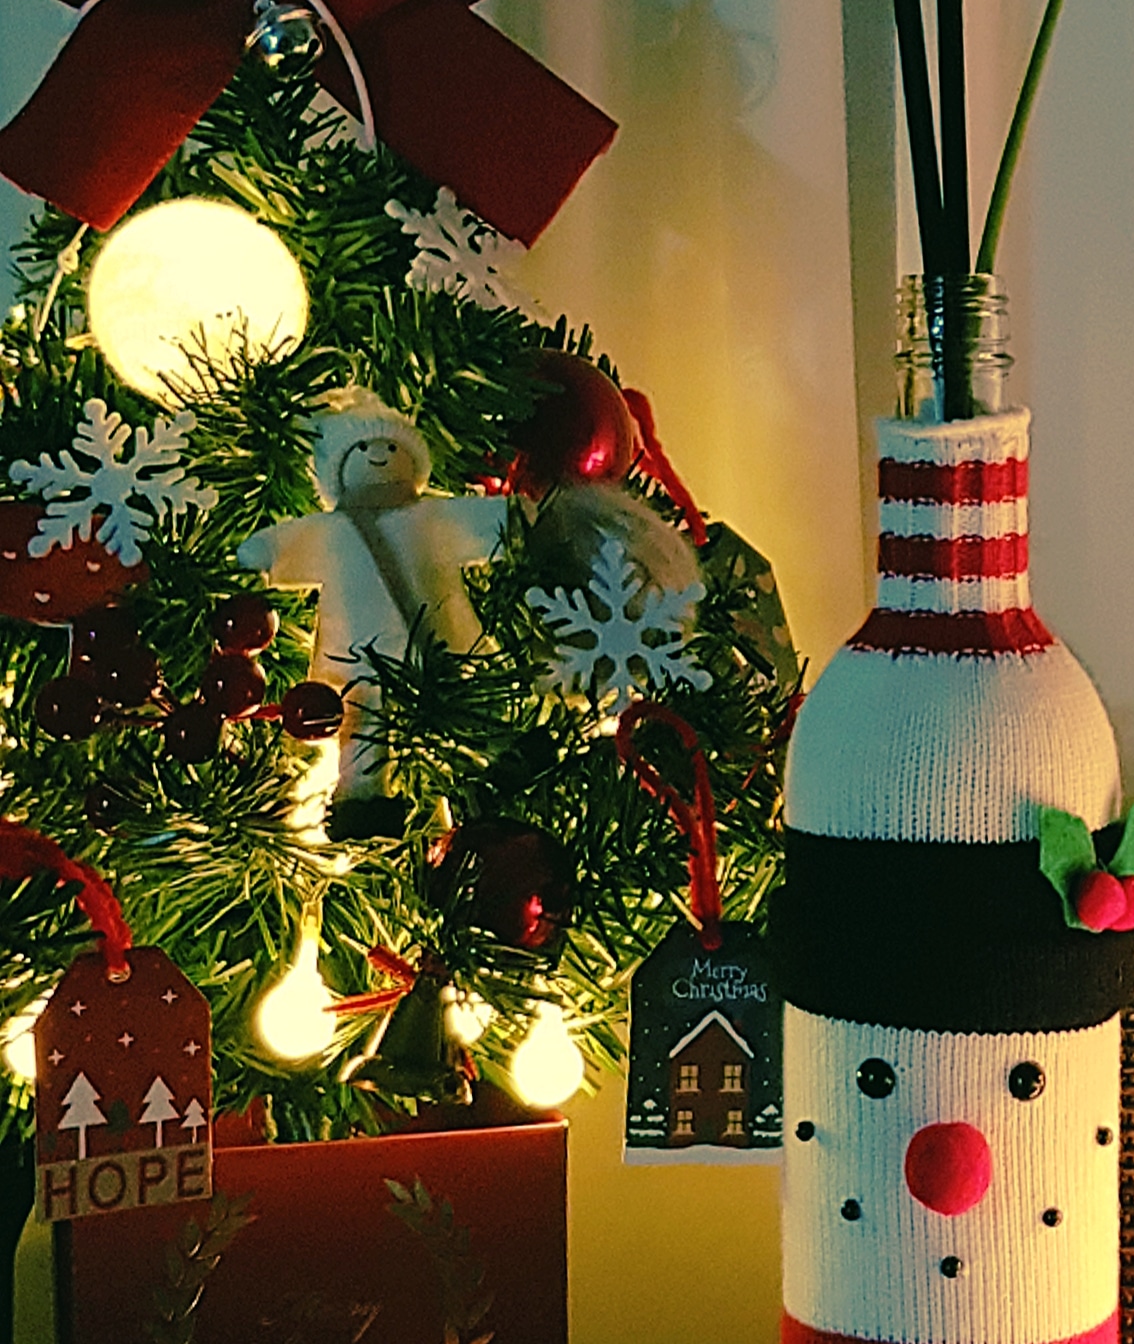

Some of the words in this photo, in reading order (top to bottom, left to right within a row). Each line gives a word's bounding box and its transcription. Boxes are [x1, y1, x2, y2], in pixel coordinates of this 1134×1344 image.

[692, 958, 748, 984] Merry
[672, 977, 768, 1002] Christmas
[44, 1150, 205, 1219] HOPE
